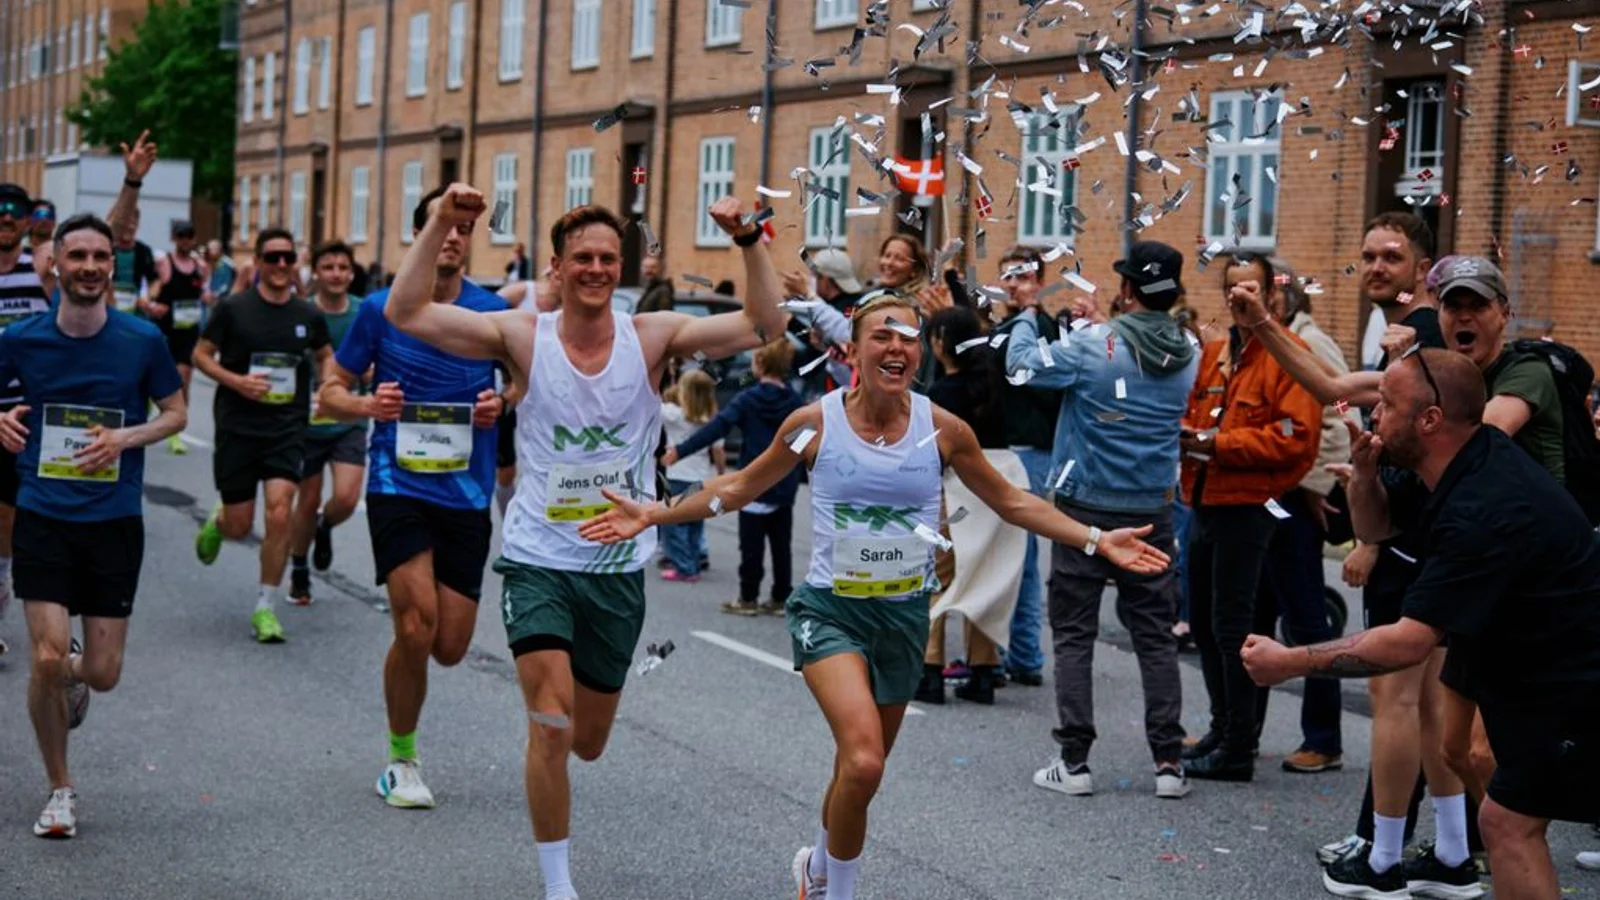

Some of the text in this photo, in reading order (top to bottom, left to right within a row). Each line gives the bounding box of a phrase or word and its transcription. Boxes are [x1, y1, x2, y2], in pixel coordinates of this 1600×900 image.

[558, 472, 619, 489] Jens Olaf
[860, 548, 903, 562] Sarah
